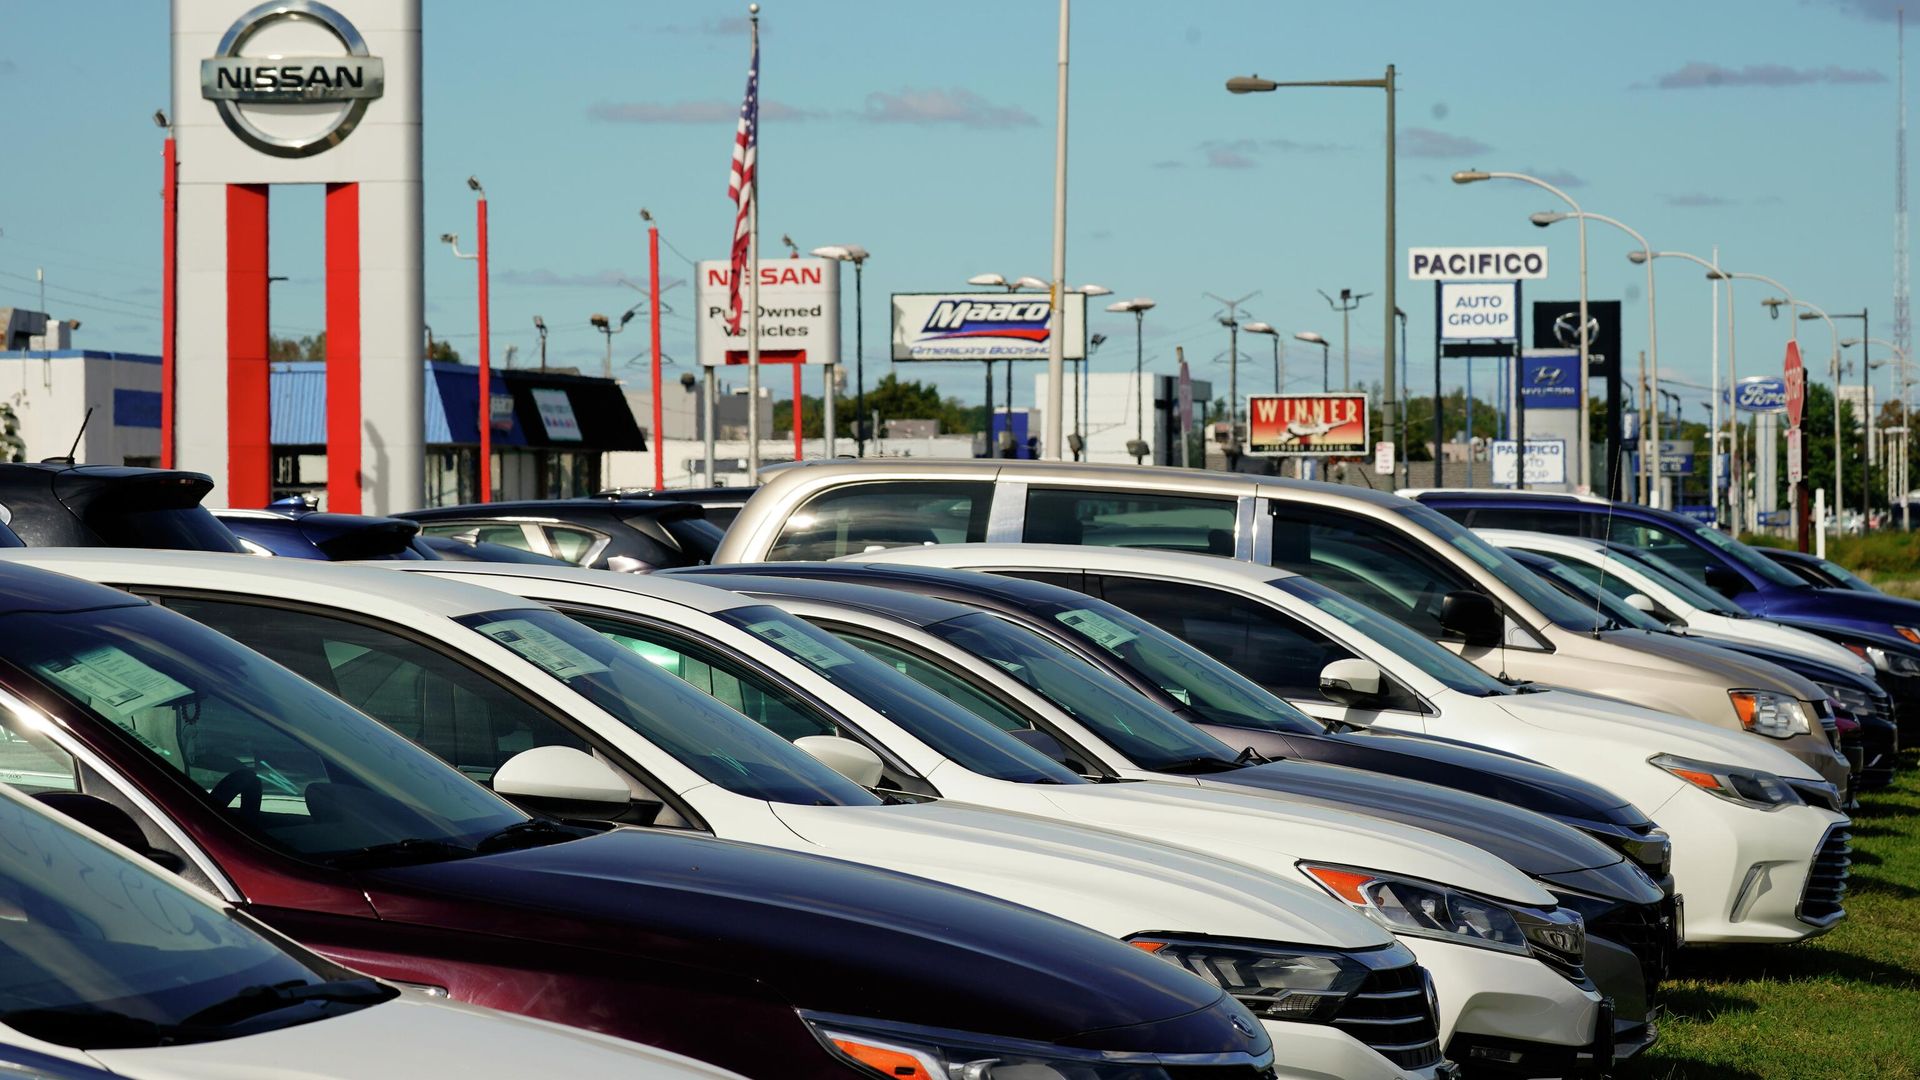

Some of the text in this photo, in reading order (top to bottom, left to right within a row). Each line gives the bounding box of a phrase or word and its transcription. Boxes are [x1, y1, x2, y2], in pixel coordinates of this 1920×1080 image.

[217, 66, 363, 89] NISSAN
[1414, 253, 1543, 275] PACIFICO
[708, 267, 821, 286] NSAN
[1456, 295, 1502, 309] AUTO
[709, 305, 822, 319] P-wned
[926, 301, 1050, 329] Maaco
[1448, 313, 1509, 326] GROUP
[723, 325, 809, 337] Veicles
[1257, 399, 1358, 423] WINNER
[1497, 445, 1560, 455] PAIFICO
[1512, 458, 1545, 467] ATO
[1506, 471, 1549, 479] GOUP
